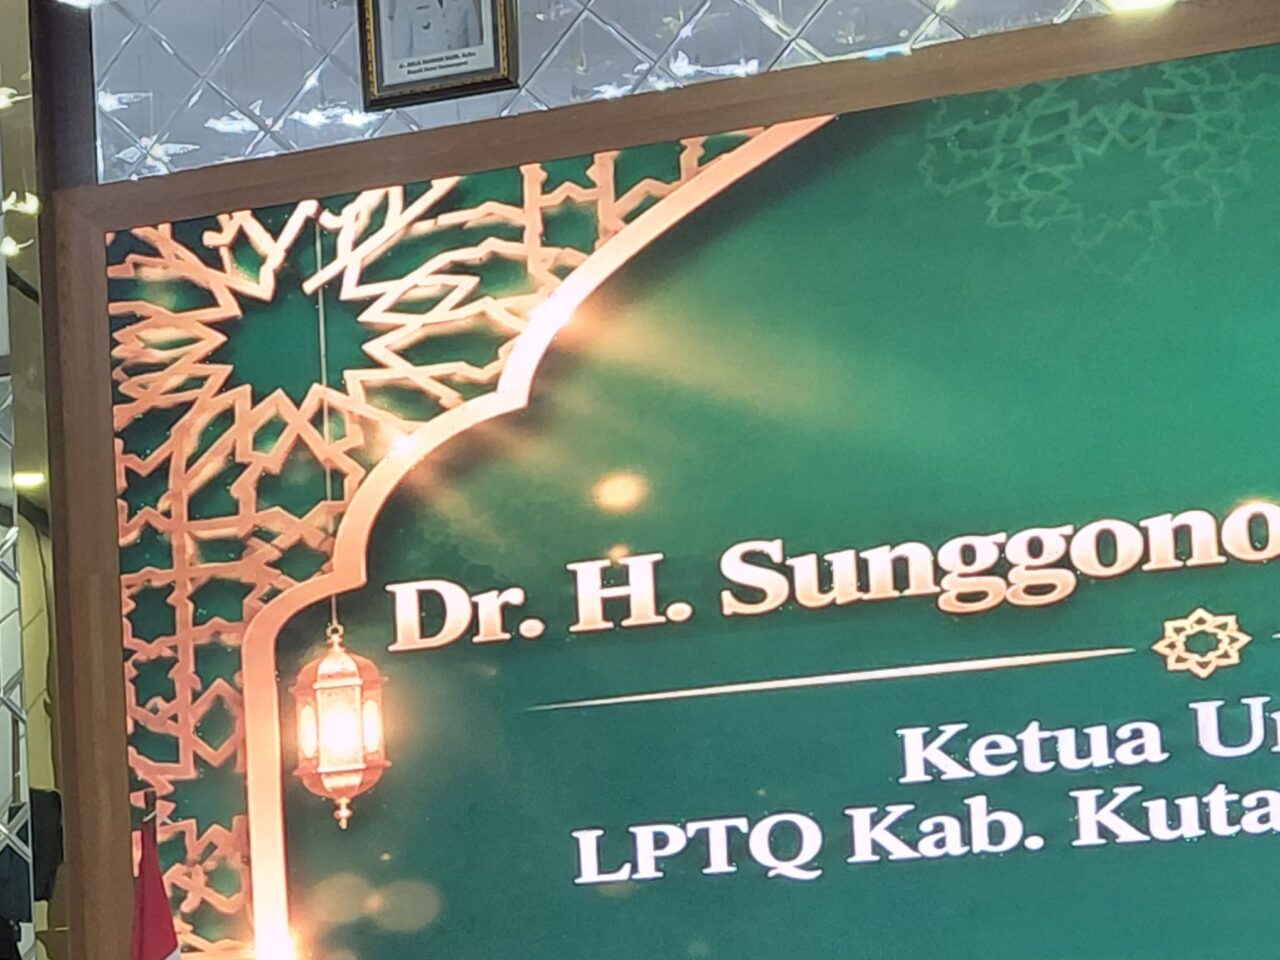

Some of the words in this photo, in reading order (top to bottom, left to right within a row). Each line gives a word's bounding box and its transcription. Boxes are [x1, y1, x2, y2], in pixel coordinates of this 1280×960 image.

[385, 577, 546, 653] Dr.
[566, 550, 694, 634] H.
[719, 499, 1280, 617] Sunggono
[896, 718, 1170, 785] Ketua
[1187, 695, 1280, 758] U
[571, 813, 824, 885] LPTQ
[844, 794, 1045, 864] Kab.
[1069, 782, 1280, 847] Kuta
